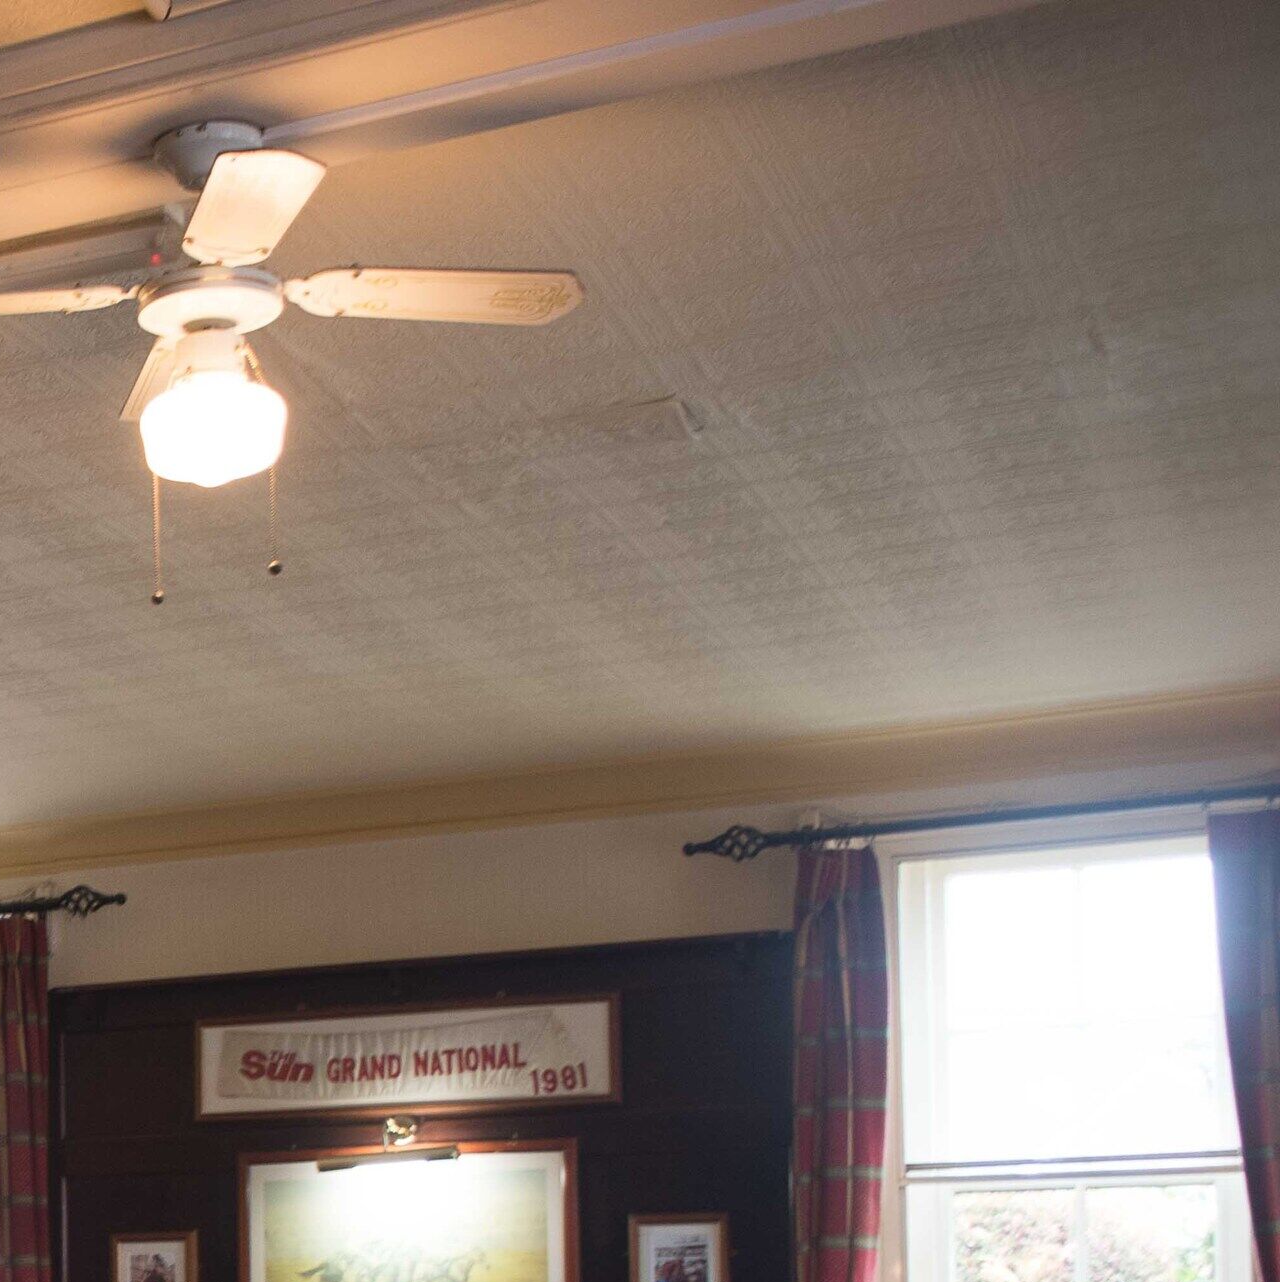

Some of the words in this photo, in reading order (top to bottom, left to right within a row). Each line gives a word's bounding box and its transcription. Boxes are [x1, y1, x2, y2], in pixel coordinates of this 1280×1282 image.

[327, 1054, 402, 1084] GRAND
[414, 1042, 527, 1077] NATIONAL
[529, 1061, 587, 1096] 1981
